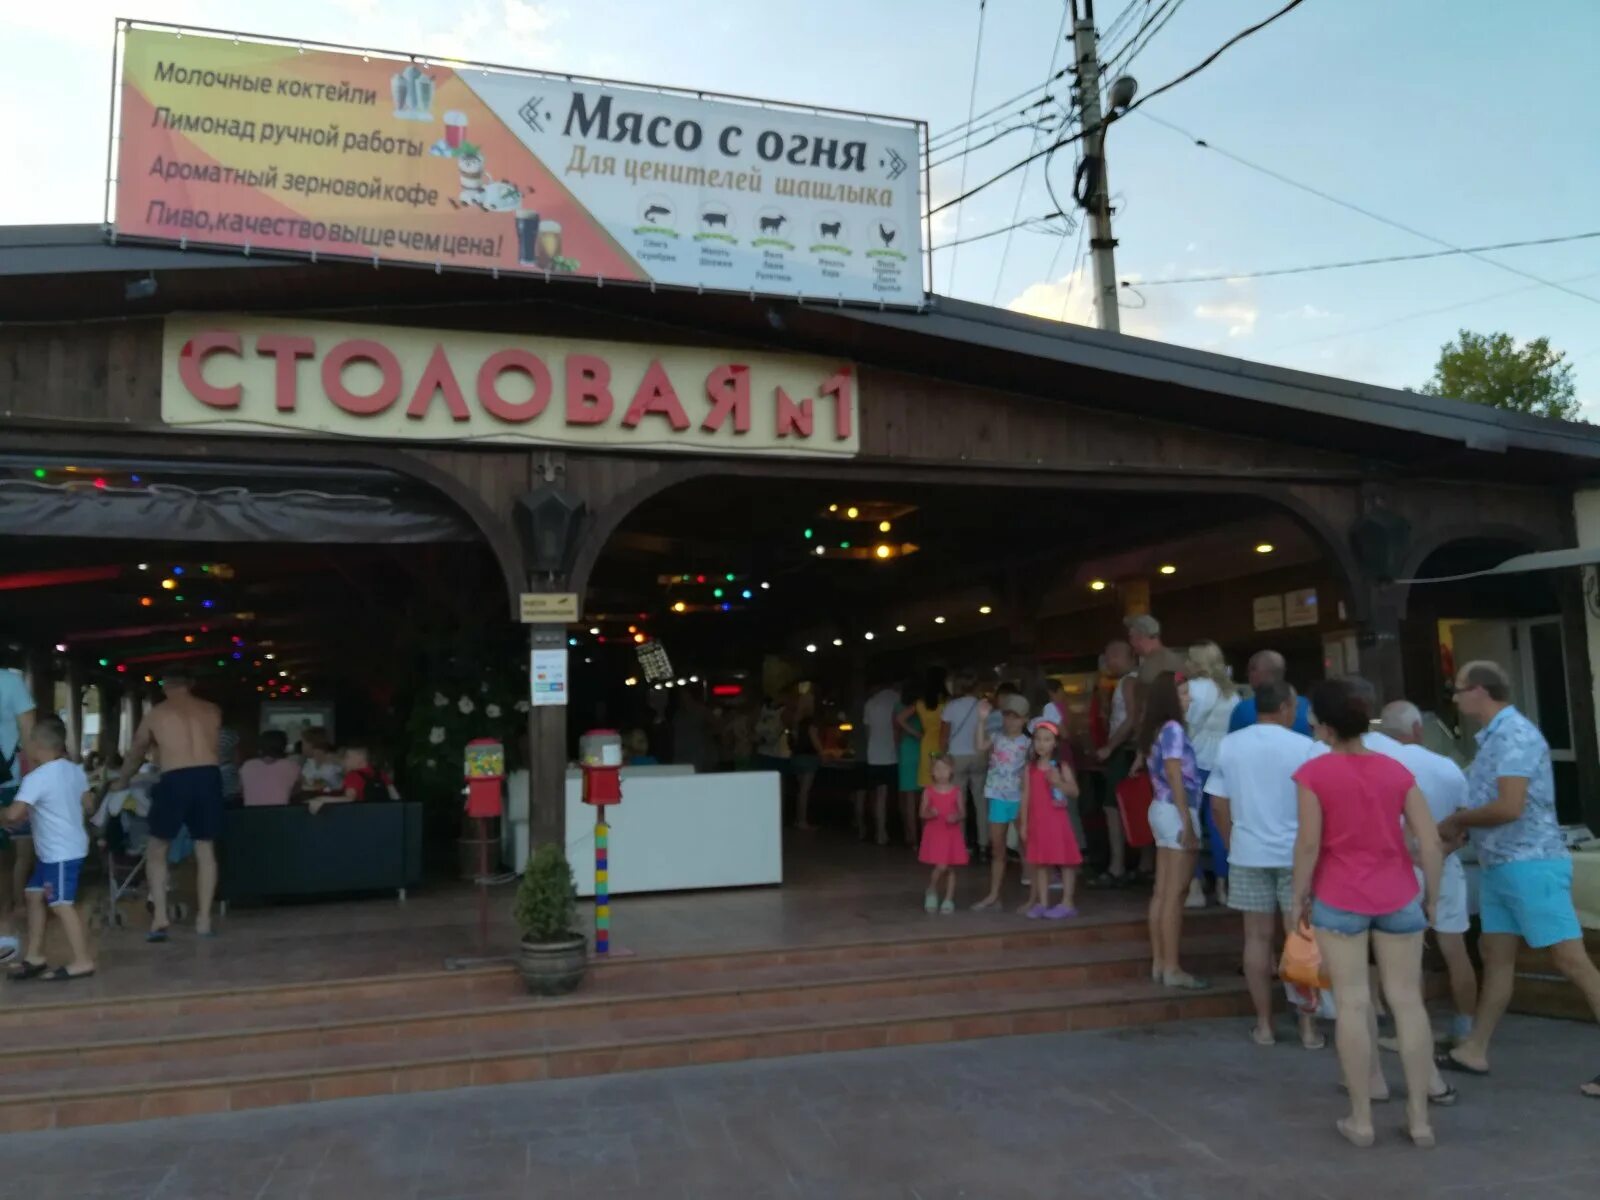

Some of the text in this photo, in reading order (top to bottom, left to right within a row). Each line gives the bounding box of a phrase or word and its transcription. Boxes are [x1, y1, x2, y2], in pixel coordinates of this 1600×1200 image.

[154, 61, 377, 106] Молочные коктейли
[152, 106, 424, 157] Лимонад ручной работы
[562, 91, 868, 173] Мясо с огня
[149, 155, 439, 208] Ароматный зерновой кофе
[565, 145, 893, 209] Для ценителей шашлыка
[328, 222, 396, 248] выше
[398, 229, 441, 252] чем
[442, 234, 504, 258] цена!
[178, 328, 751, 436] СТОЛОВАЯ
